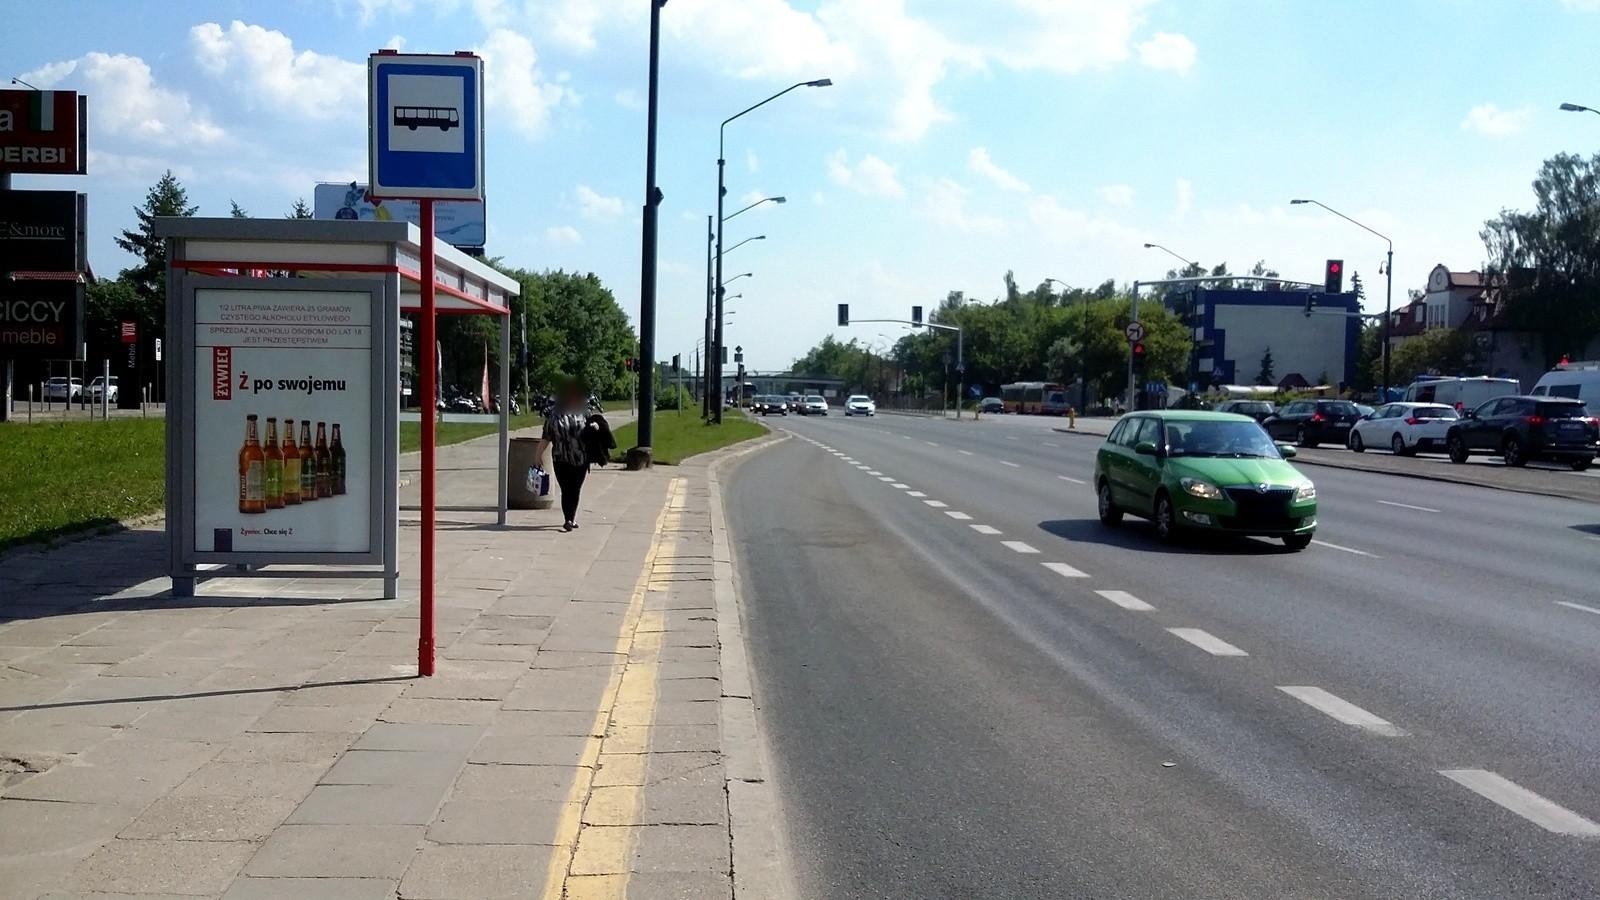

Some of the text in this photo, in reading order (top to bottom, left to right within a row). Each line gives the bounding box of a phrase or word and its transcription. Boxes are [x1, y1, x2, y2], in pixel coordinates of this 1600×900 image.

[0, 146, 66, 164] ERBI
[0, 300, 66, 322] ICCY
[231, 304, 251, 312] LITRA
[252, 304, 271, 312] PIWA
[220, 313, 261, 321] CZYSTEGO
[2, 328, 57, 345] meble
[121, 322, 136, 337] VOX
[250, 327, 290, 335] ALKOHOLU
[215, 348, 229, 397] ŻYWIEC
[239, 371, 346, 395] Ż po swojemu
